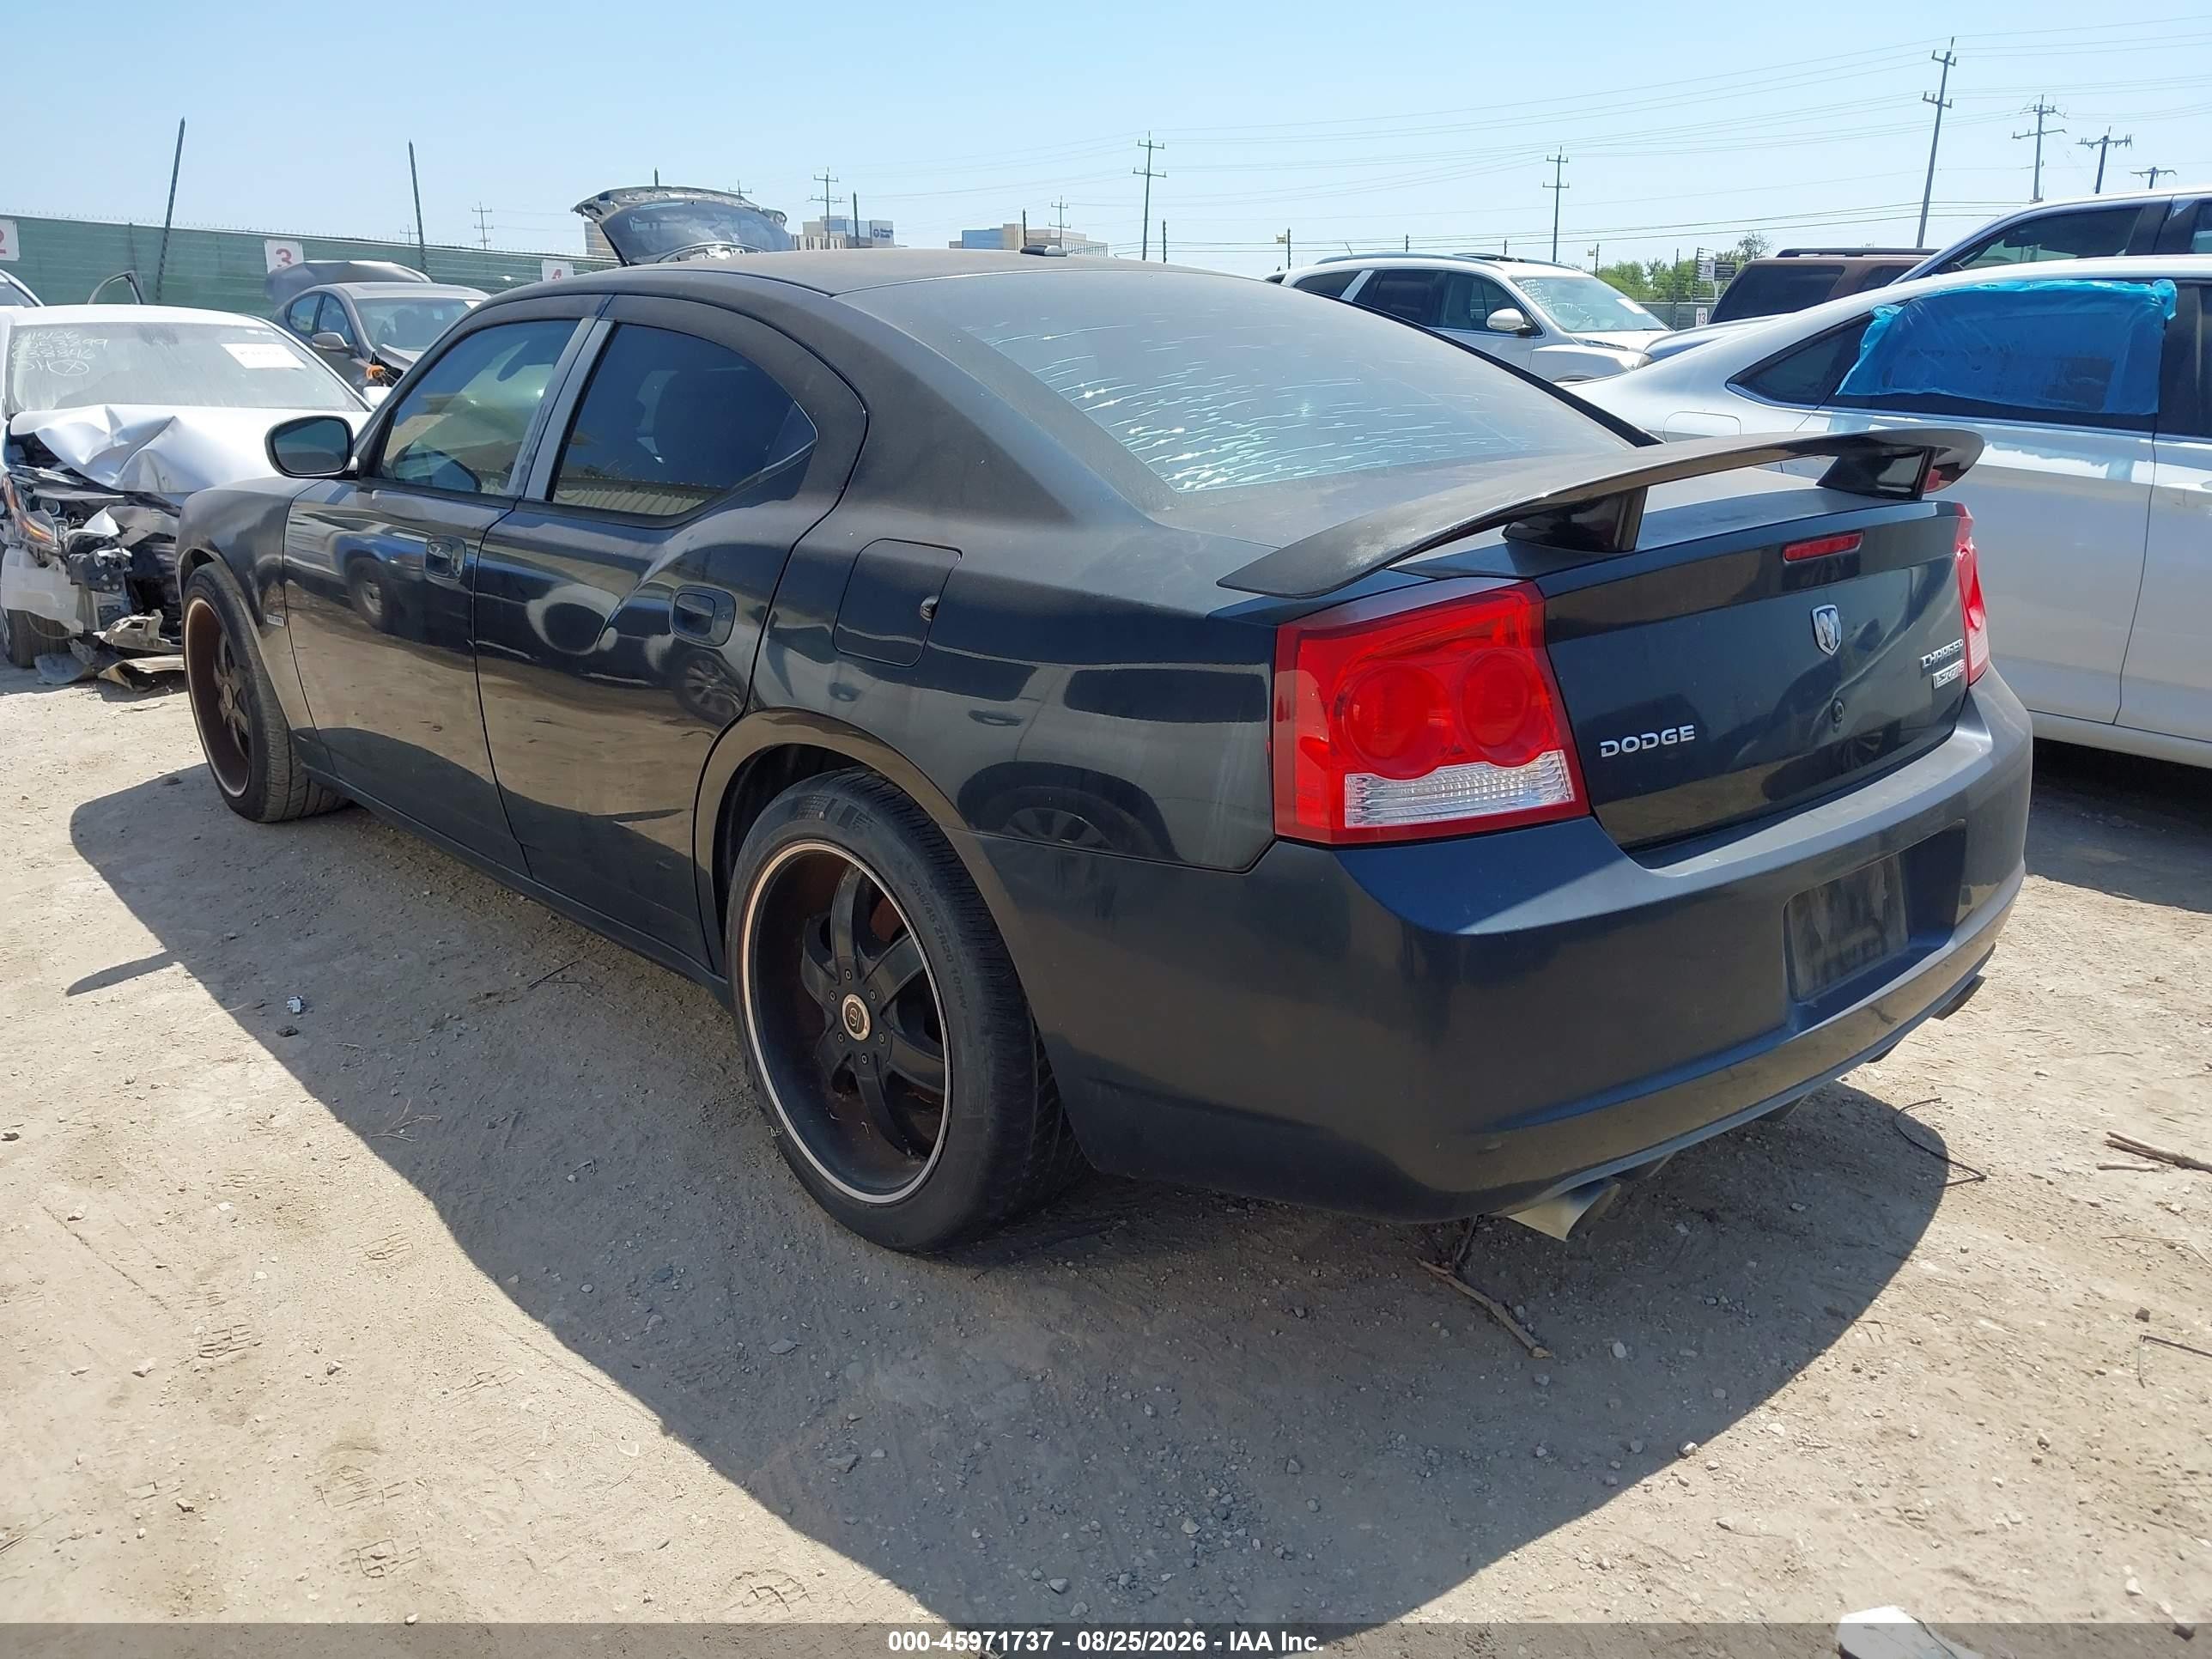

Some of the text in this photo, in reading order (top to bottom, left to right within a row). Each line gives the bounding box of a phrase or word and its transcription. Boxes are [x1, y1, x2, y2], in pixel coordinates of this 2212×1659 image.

[276, 247, 293, 268] 3
[1697, 312, 1707, 325] 13
[1600, 724, 1696, 757] DODGE
